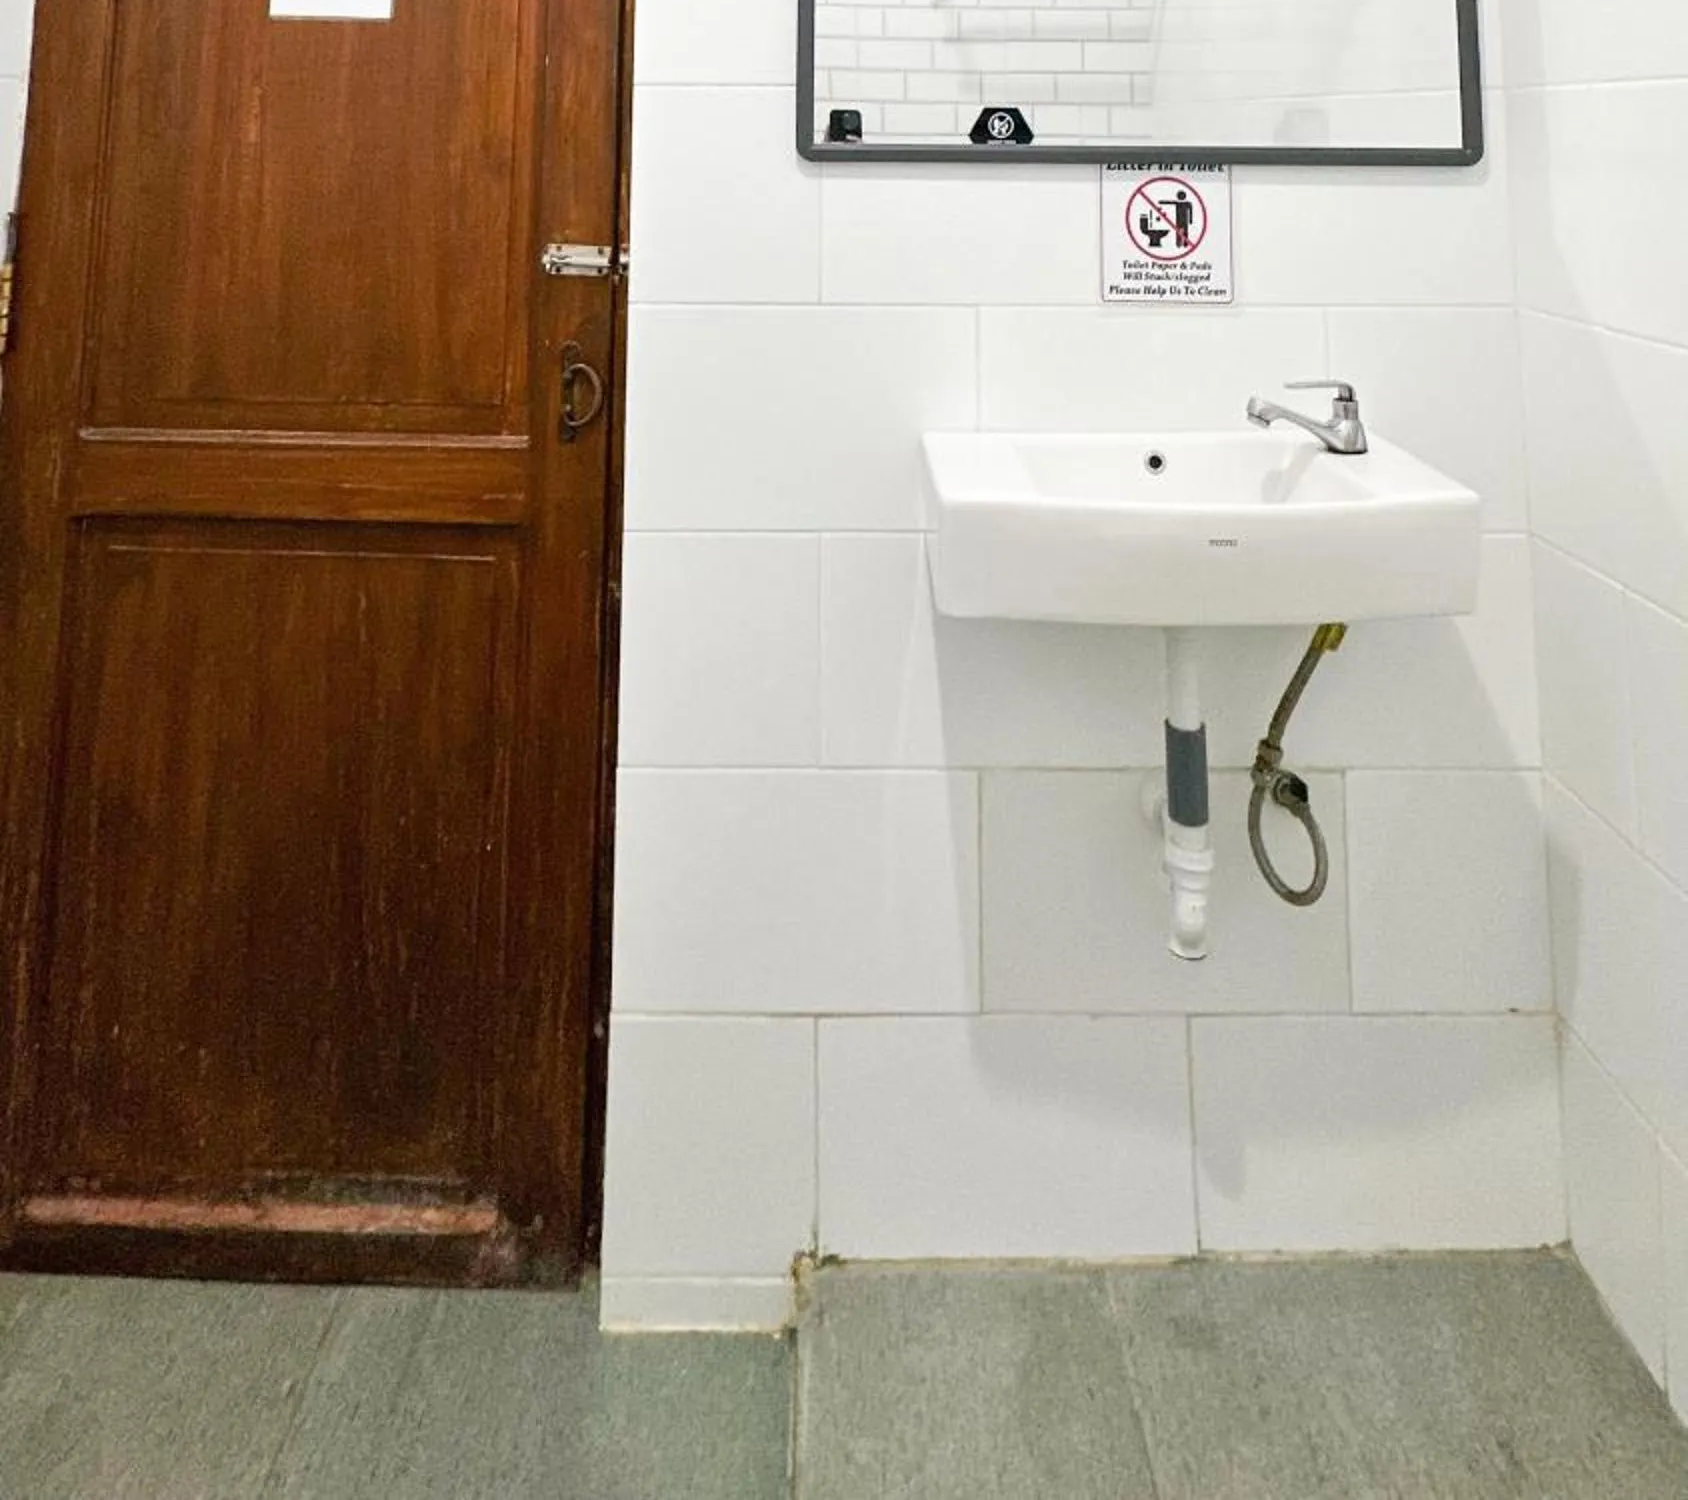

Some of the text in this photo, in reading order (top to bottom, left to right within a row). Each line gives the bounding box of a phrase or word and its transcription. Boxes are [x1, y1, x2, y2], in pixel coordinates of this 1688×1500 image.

[1122, 261, 1149, 269] Toilet
[1151, 262, 1177, 271] Paper
[1179, 262, 1187, 270] &
[1123, 272, 1143, 280] Will
[1109, 285, 1227, 297] Please Help Us To Clean
